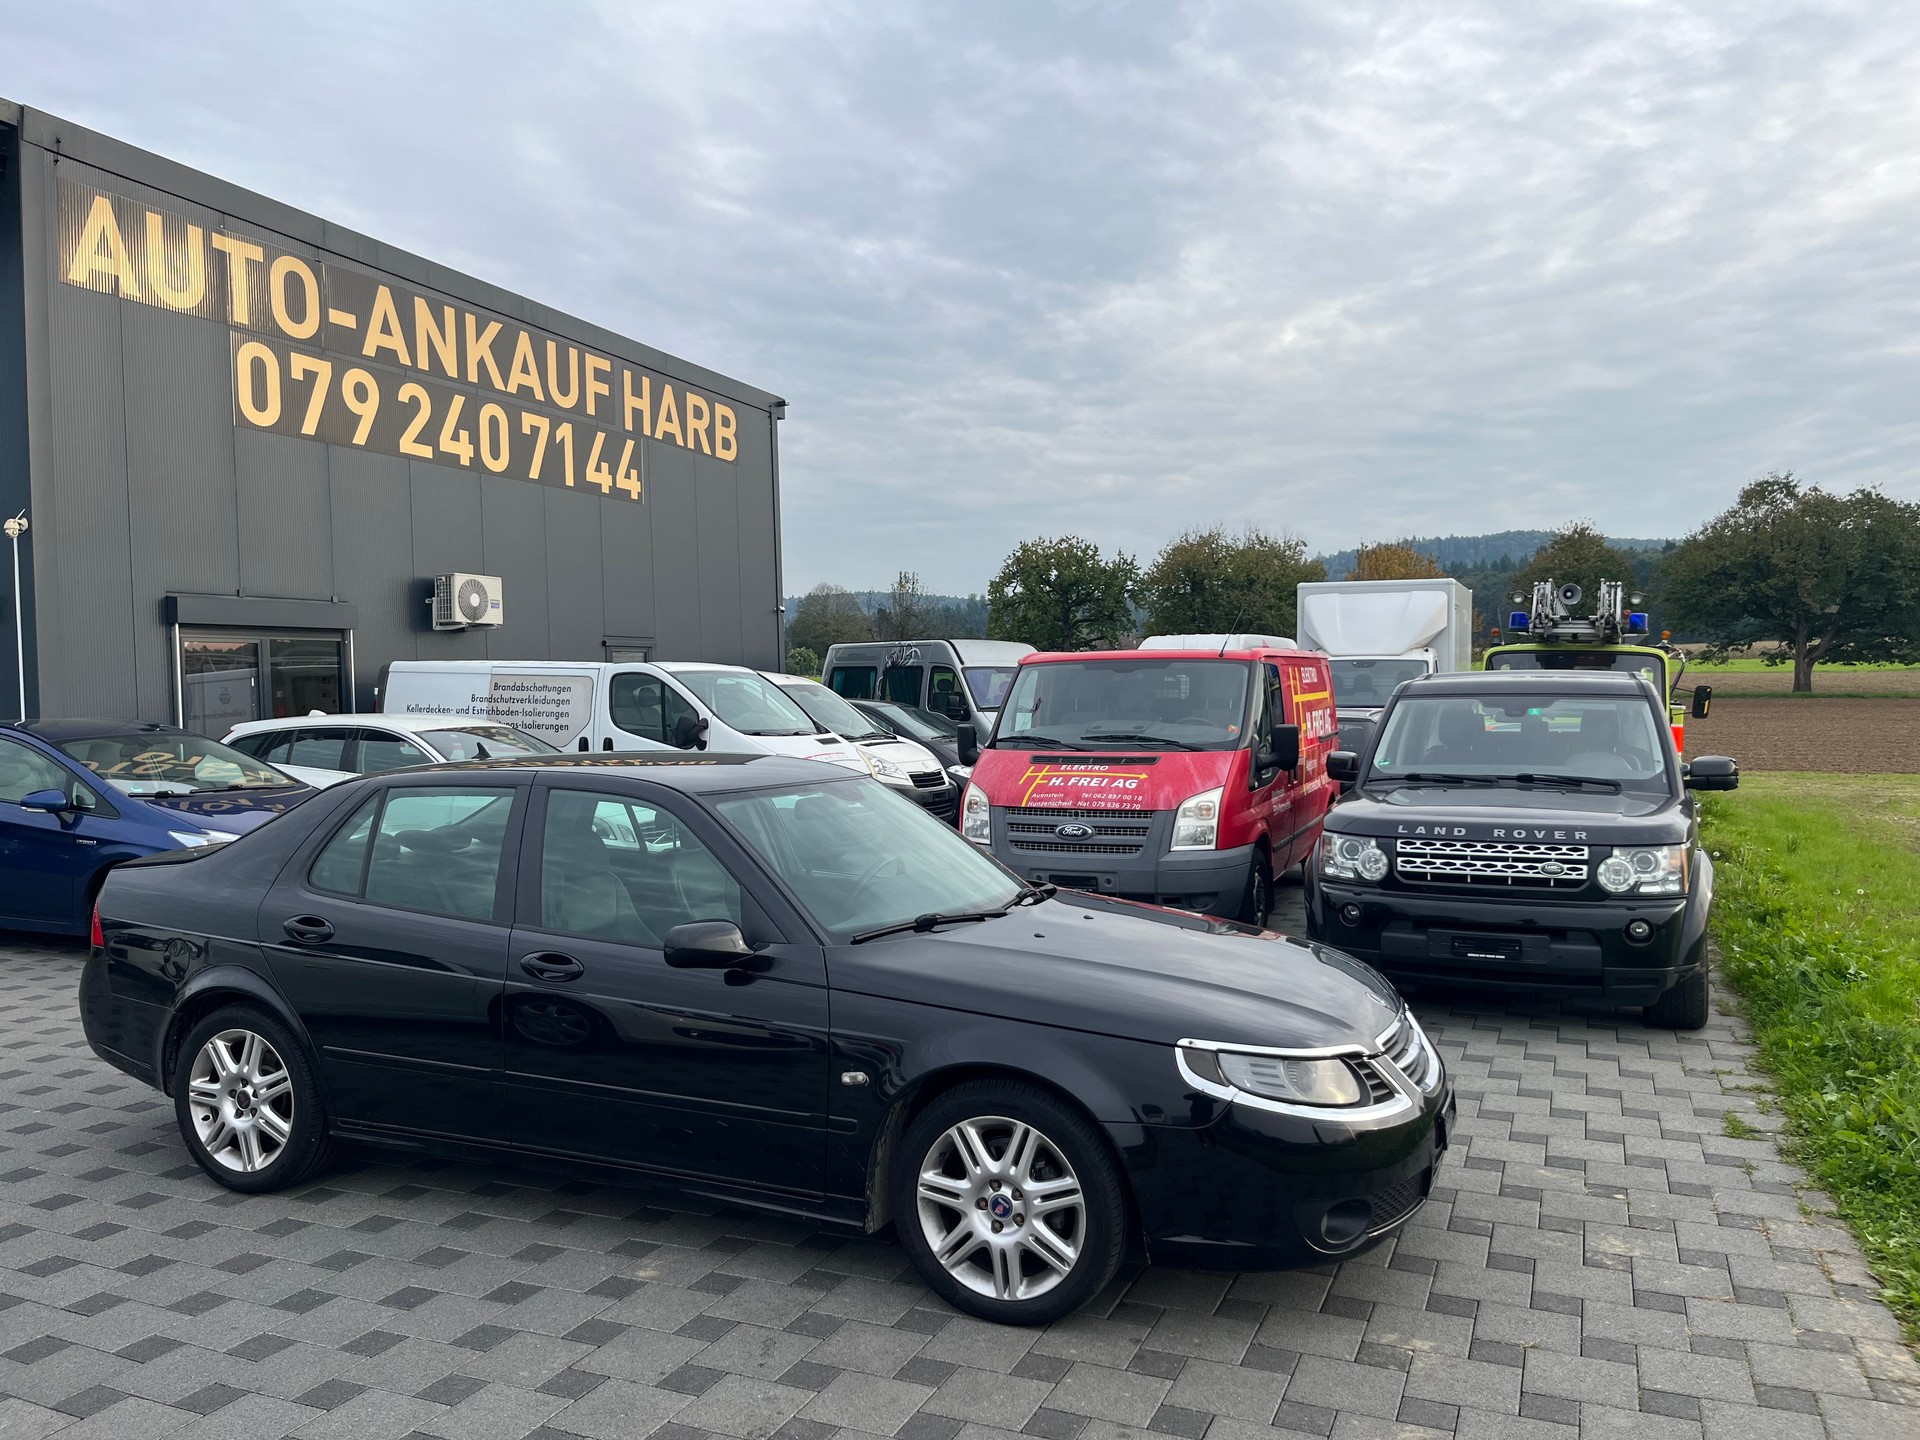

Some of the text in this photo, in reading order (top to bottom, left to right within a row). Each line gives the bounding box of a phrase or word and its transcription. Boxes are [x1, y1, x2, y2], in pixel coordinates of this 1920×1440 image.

[68, 195, 738, 462] AUTO-ANKAUF HARB
[236, 341, 380, 446] 079
[397, 381, 509, 472] 240
[493, 682, 572, 696] Brandabschottungen
[470, 694, 571, 708] Brandschutzverkleidungen
[406, 704, 570, 720] Kellerdecken- und Estrichboden-Isolierungen
[1048, 776, 1139, 789] H. FREI AG
[1107, 793, 1121, 801] 897
[1028, 800, 1073, 808] Hunzenschwil
[1121, 802, 1131, 810] 73
[1131, 803, 1141, 811] 70
[1062, 826, 1083, 836] Ford
[1397, 825, 1588, 841] LAND ROVER
